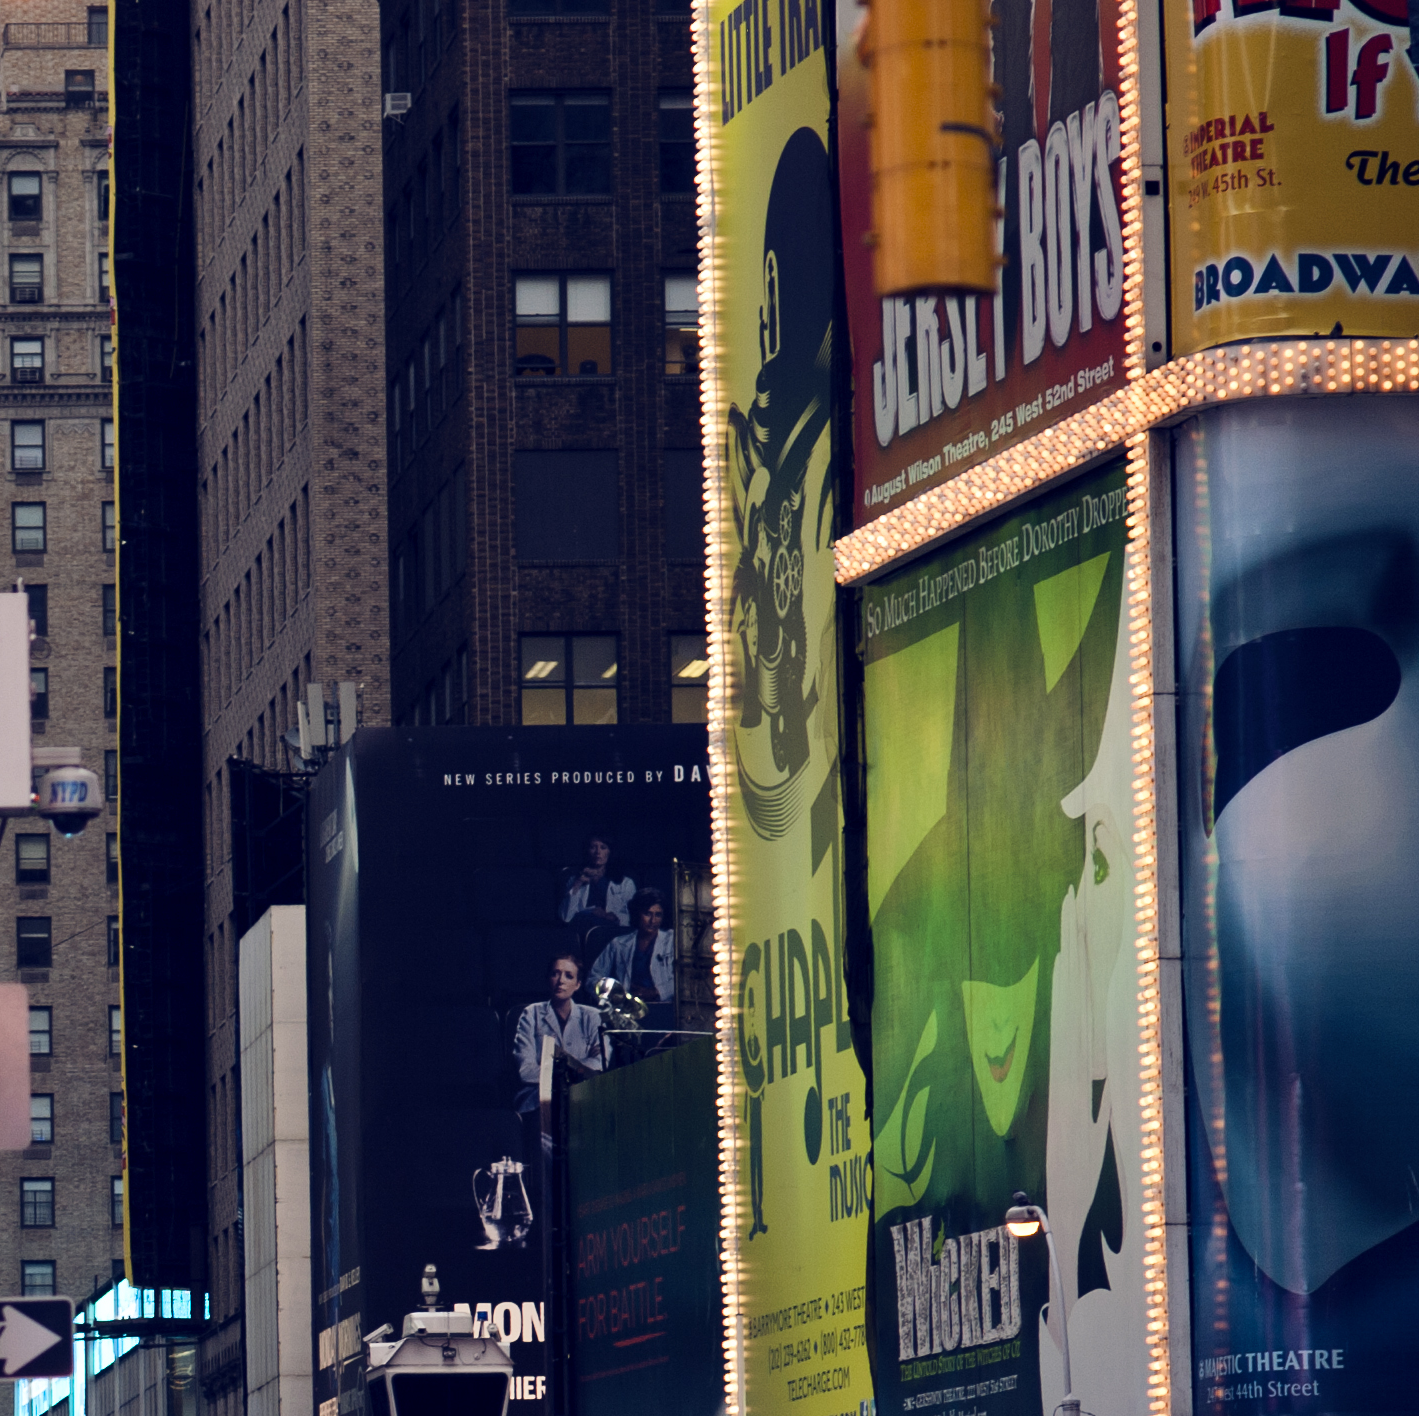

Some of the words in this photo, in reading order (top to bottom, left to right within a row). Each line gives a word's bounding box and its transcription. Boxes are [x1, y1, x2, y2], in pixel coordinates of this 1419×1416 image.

[1326, 27, 1394, 120] If
[1190, 111, 1275, 156] IMPERIAL
[1190, 138, 1265, 179] THEATRE
[1212, 169, 1249, 194] 45th
[1257, 168, 1283, 189] St.
[1017, 89, 1124, 367] BOYS
[872, 477, 907, 505] August
[908, 457, 942, 484] Wilson
[991, 416, 1014, 438] 245
[1016, 399, 1044, 427] West
[1045, 376, 1075, 409] 52nd
[1077, 355, 1115, 393] Street
[884, 592, 917, 631] MUCH
[918, 559, 977, 614] HAPPENED
[978, 536, 1020, 585] BEFORE
[1022, 502, 1080, 564] DOROTHY
[444, 773, 475, 786] NEW
[485, 772, 542, 785] SERIES
[552, 771, 635, 784] PRODUCED
[645, 770, 663, 783] BY
[828, 1092, 851, 1156] THE
[578, 1229, 608, 1280] ARM
[610, 1205, 686, 1269] YOURSELF
[579, 1292, 608, 1342] FOR
[1245, 1349, 1345, 1373] THEATRE
[1236, 1380, 1263, 1400] 44th
[1268, 1379, 1320, 1398] Street
